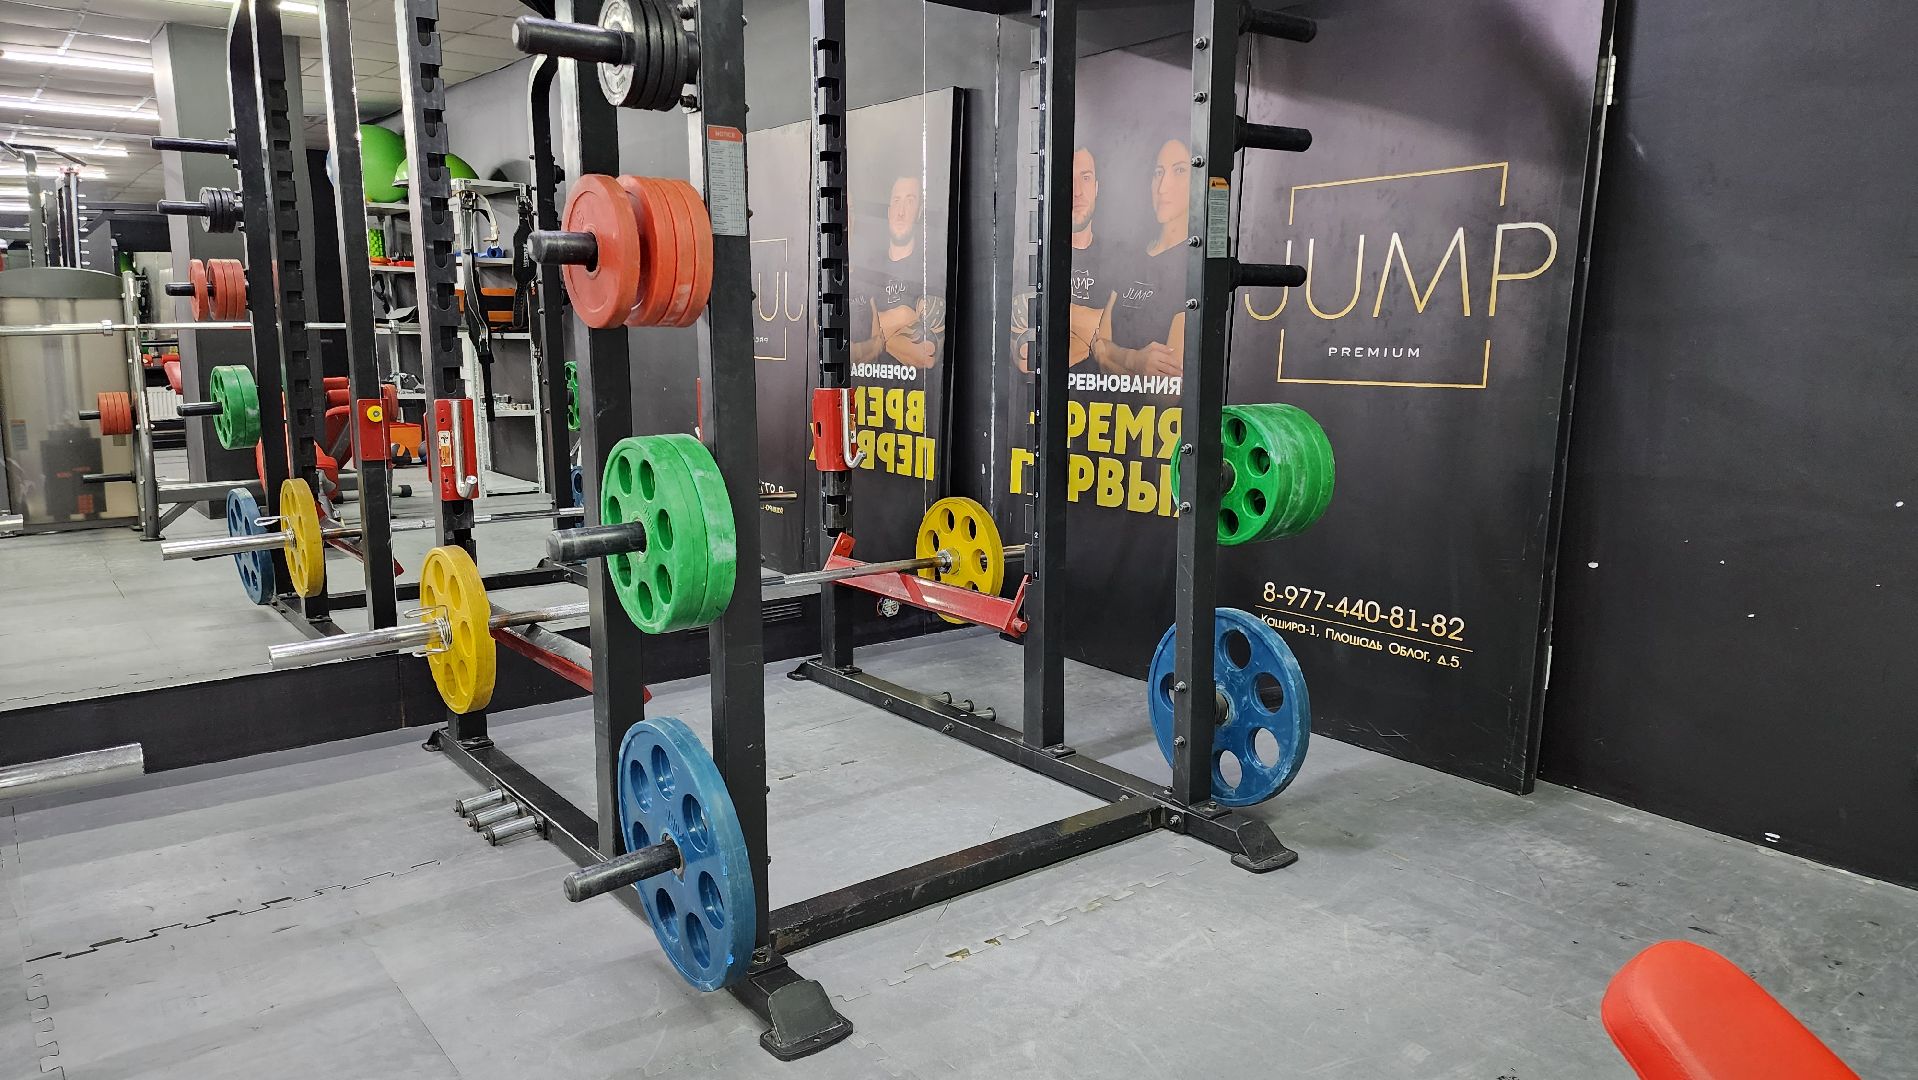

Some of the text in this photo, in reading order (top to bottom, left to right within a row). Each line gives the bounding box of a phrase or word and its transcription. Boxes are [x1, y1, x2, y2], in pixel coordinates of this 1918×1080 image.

[1244, 222, 1558, 321] JUMP
[1328, 346, 1422, 358] PREMIUM
[1030, 400, 1183, 460] РЕМЯ
[1263, 581, 1465, 642] 8-977-440-81-82
